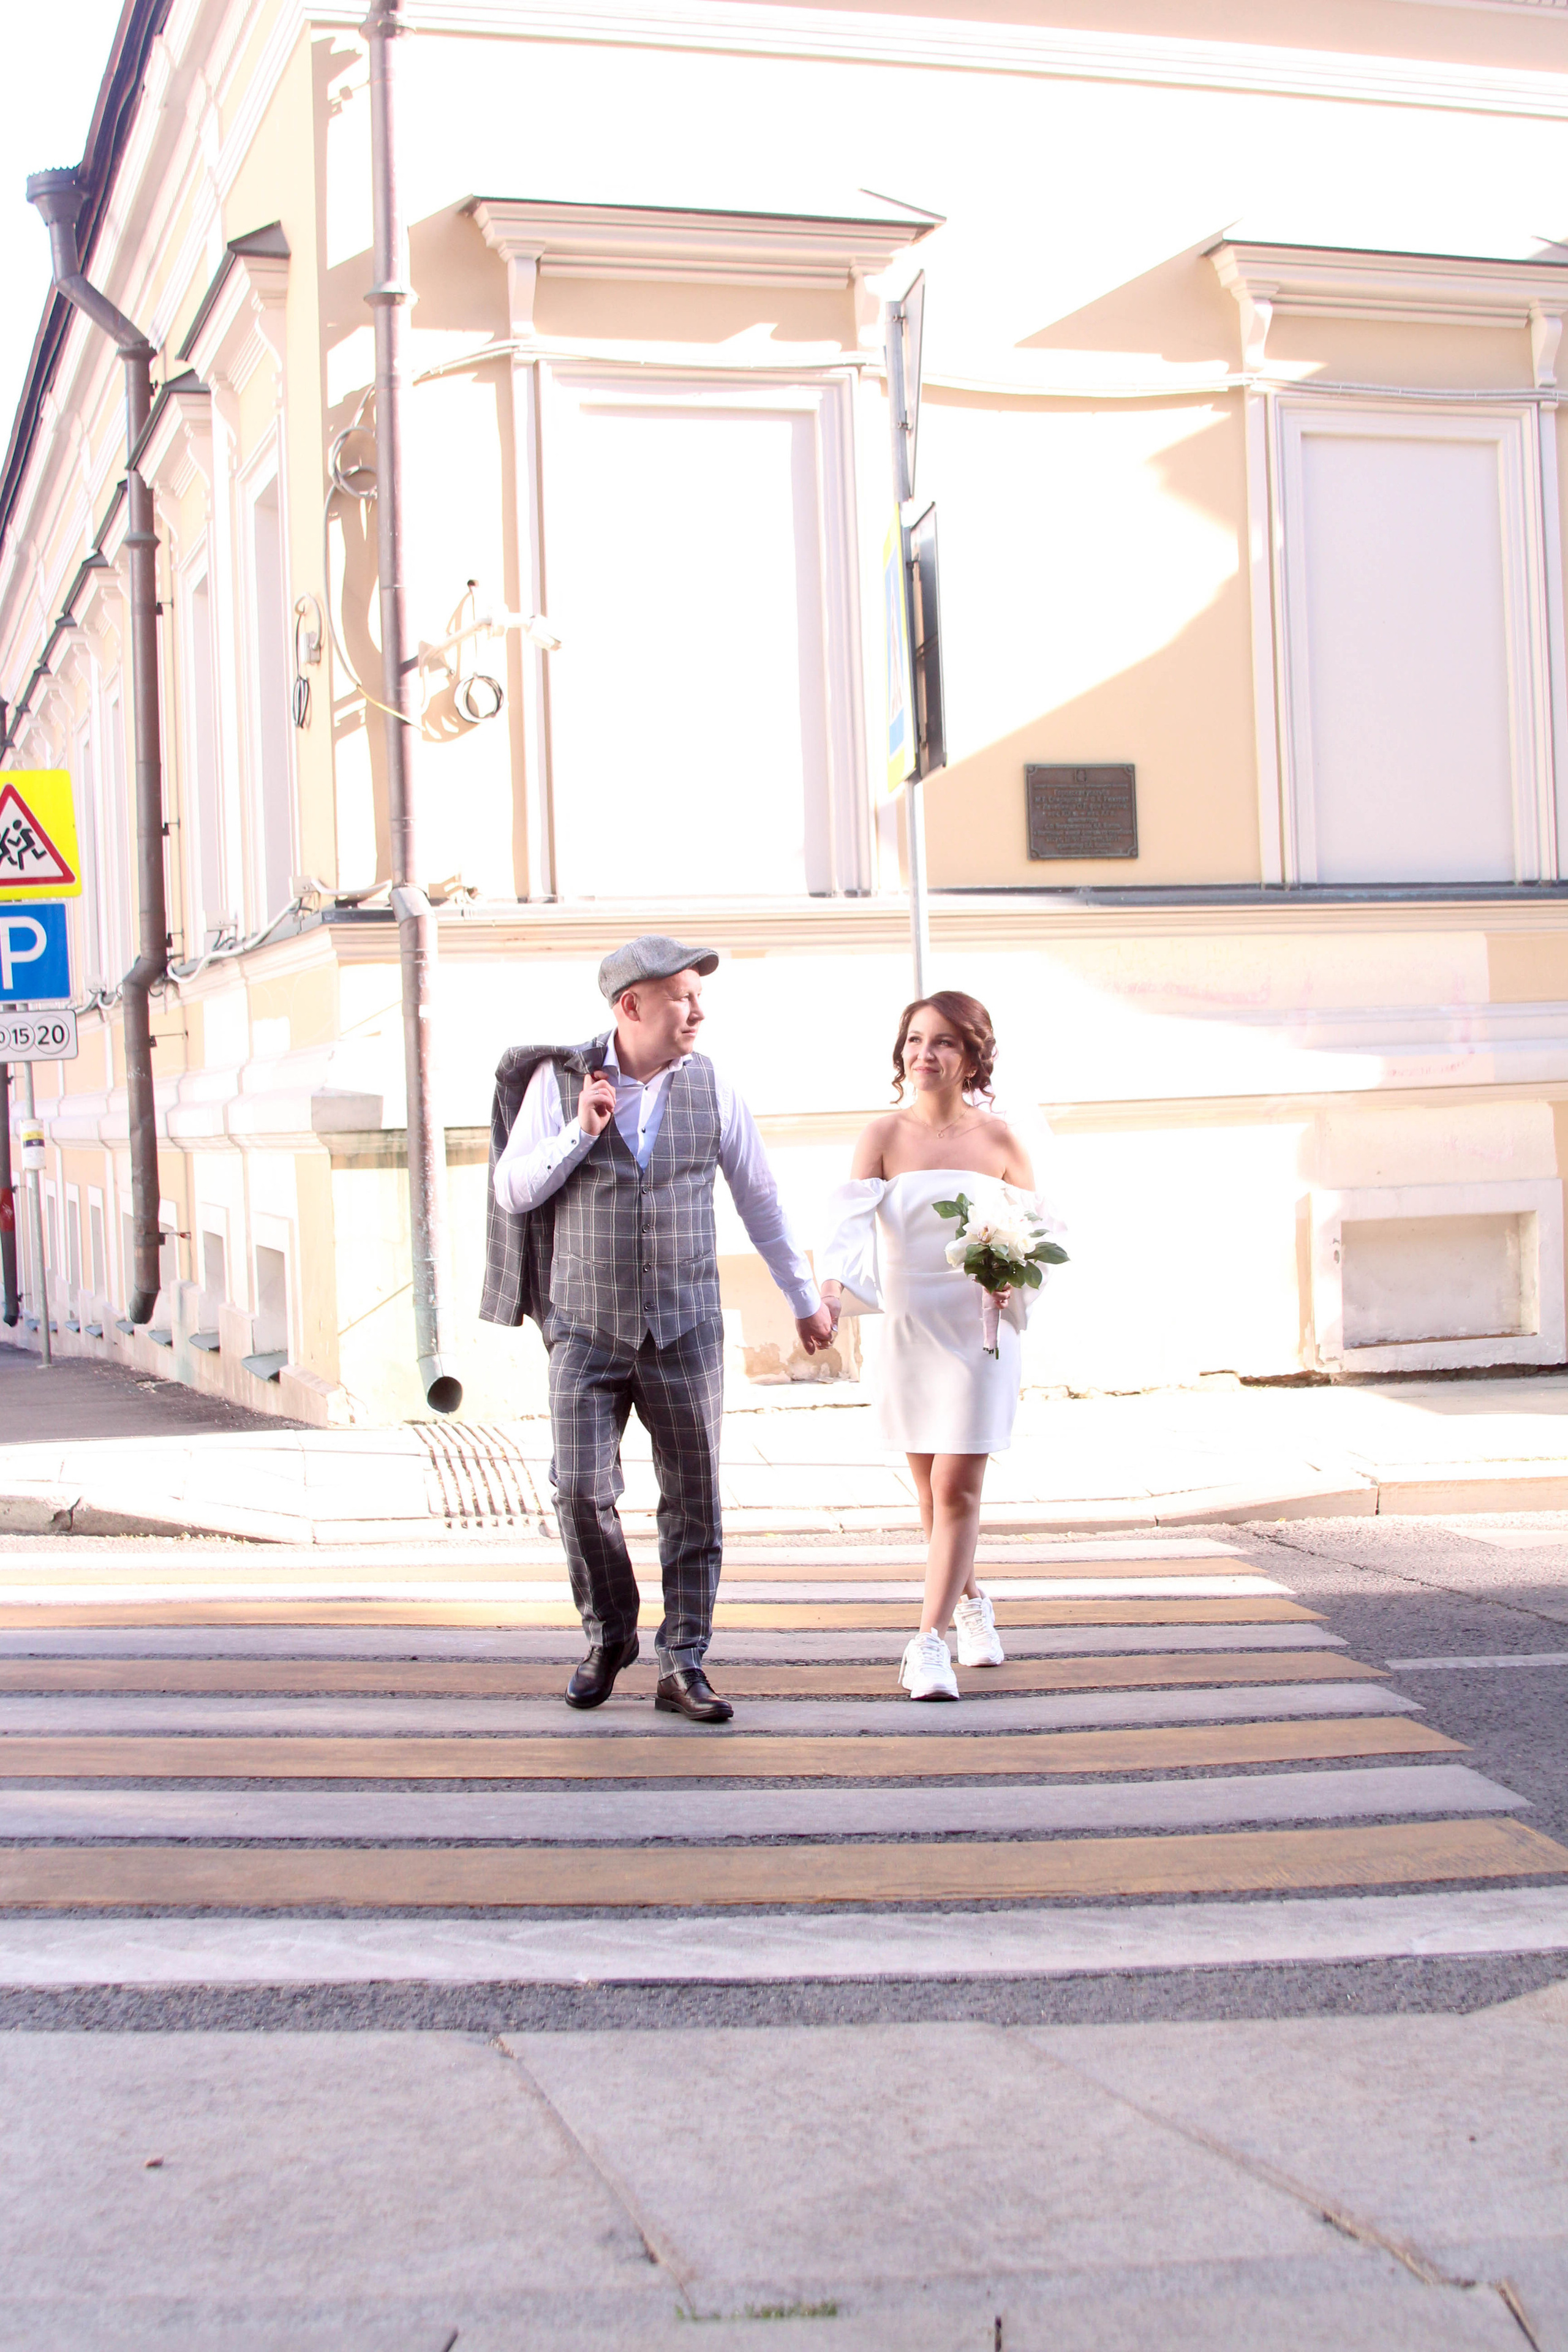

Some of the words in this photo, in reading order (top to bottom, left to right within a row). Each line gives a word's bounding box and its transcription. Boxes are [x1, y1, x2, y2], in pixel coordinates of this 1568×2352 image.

[0, 916, 47, 990] P
[0, 1031, 5, 1044] 0
[12, 1028, 29, 1044] 15
[37, 1025, 64, 1045] 20
